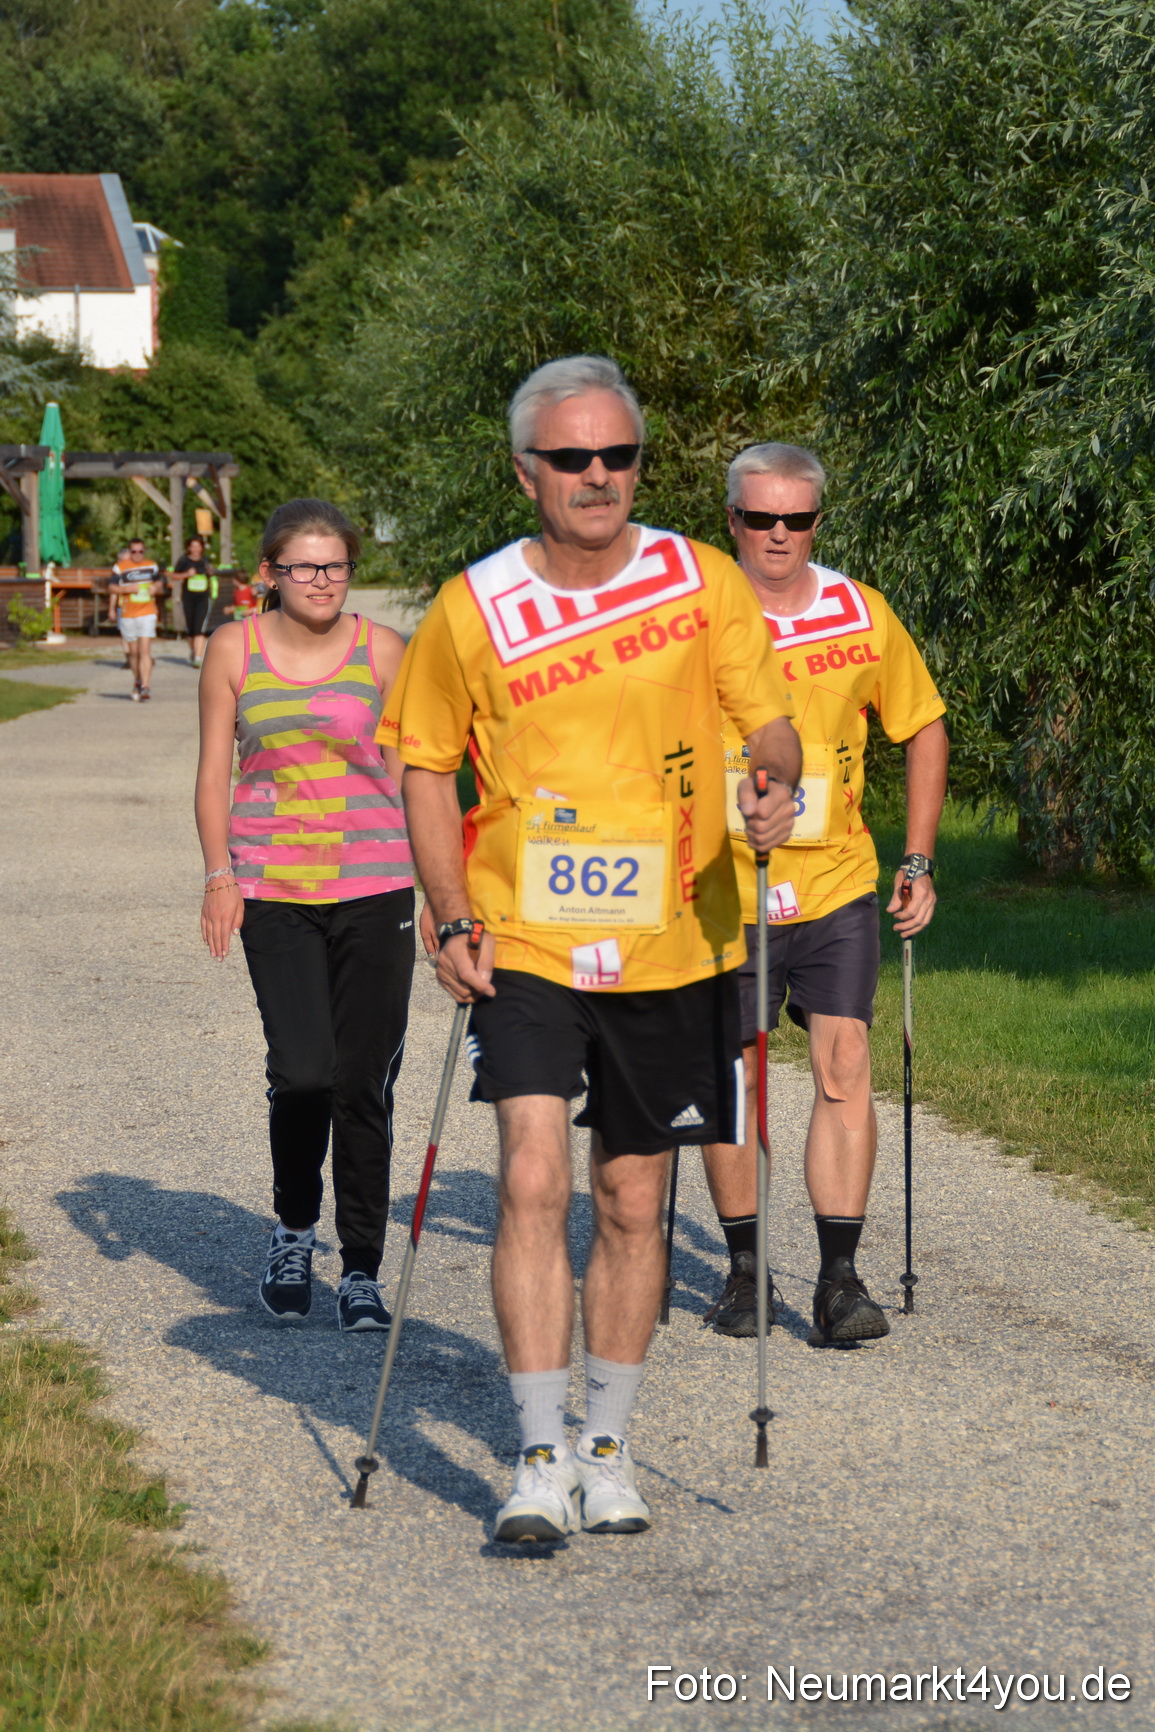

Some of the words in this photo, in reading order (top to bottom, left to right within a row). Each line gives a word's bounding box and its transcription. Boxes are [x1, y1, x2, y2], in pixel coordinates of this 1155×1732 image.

[507, 648, 605, 708] MAX
[612, 607, 709, 664] BÖGL
[805, 643, 881, 676] BÖGL
[548, 854, 640, 897] 862
[558, 905, 587, 914] Anton
